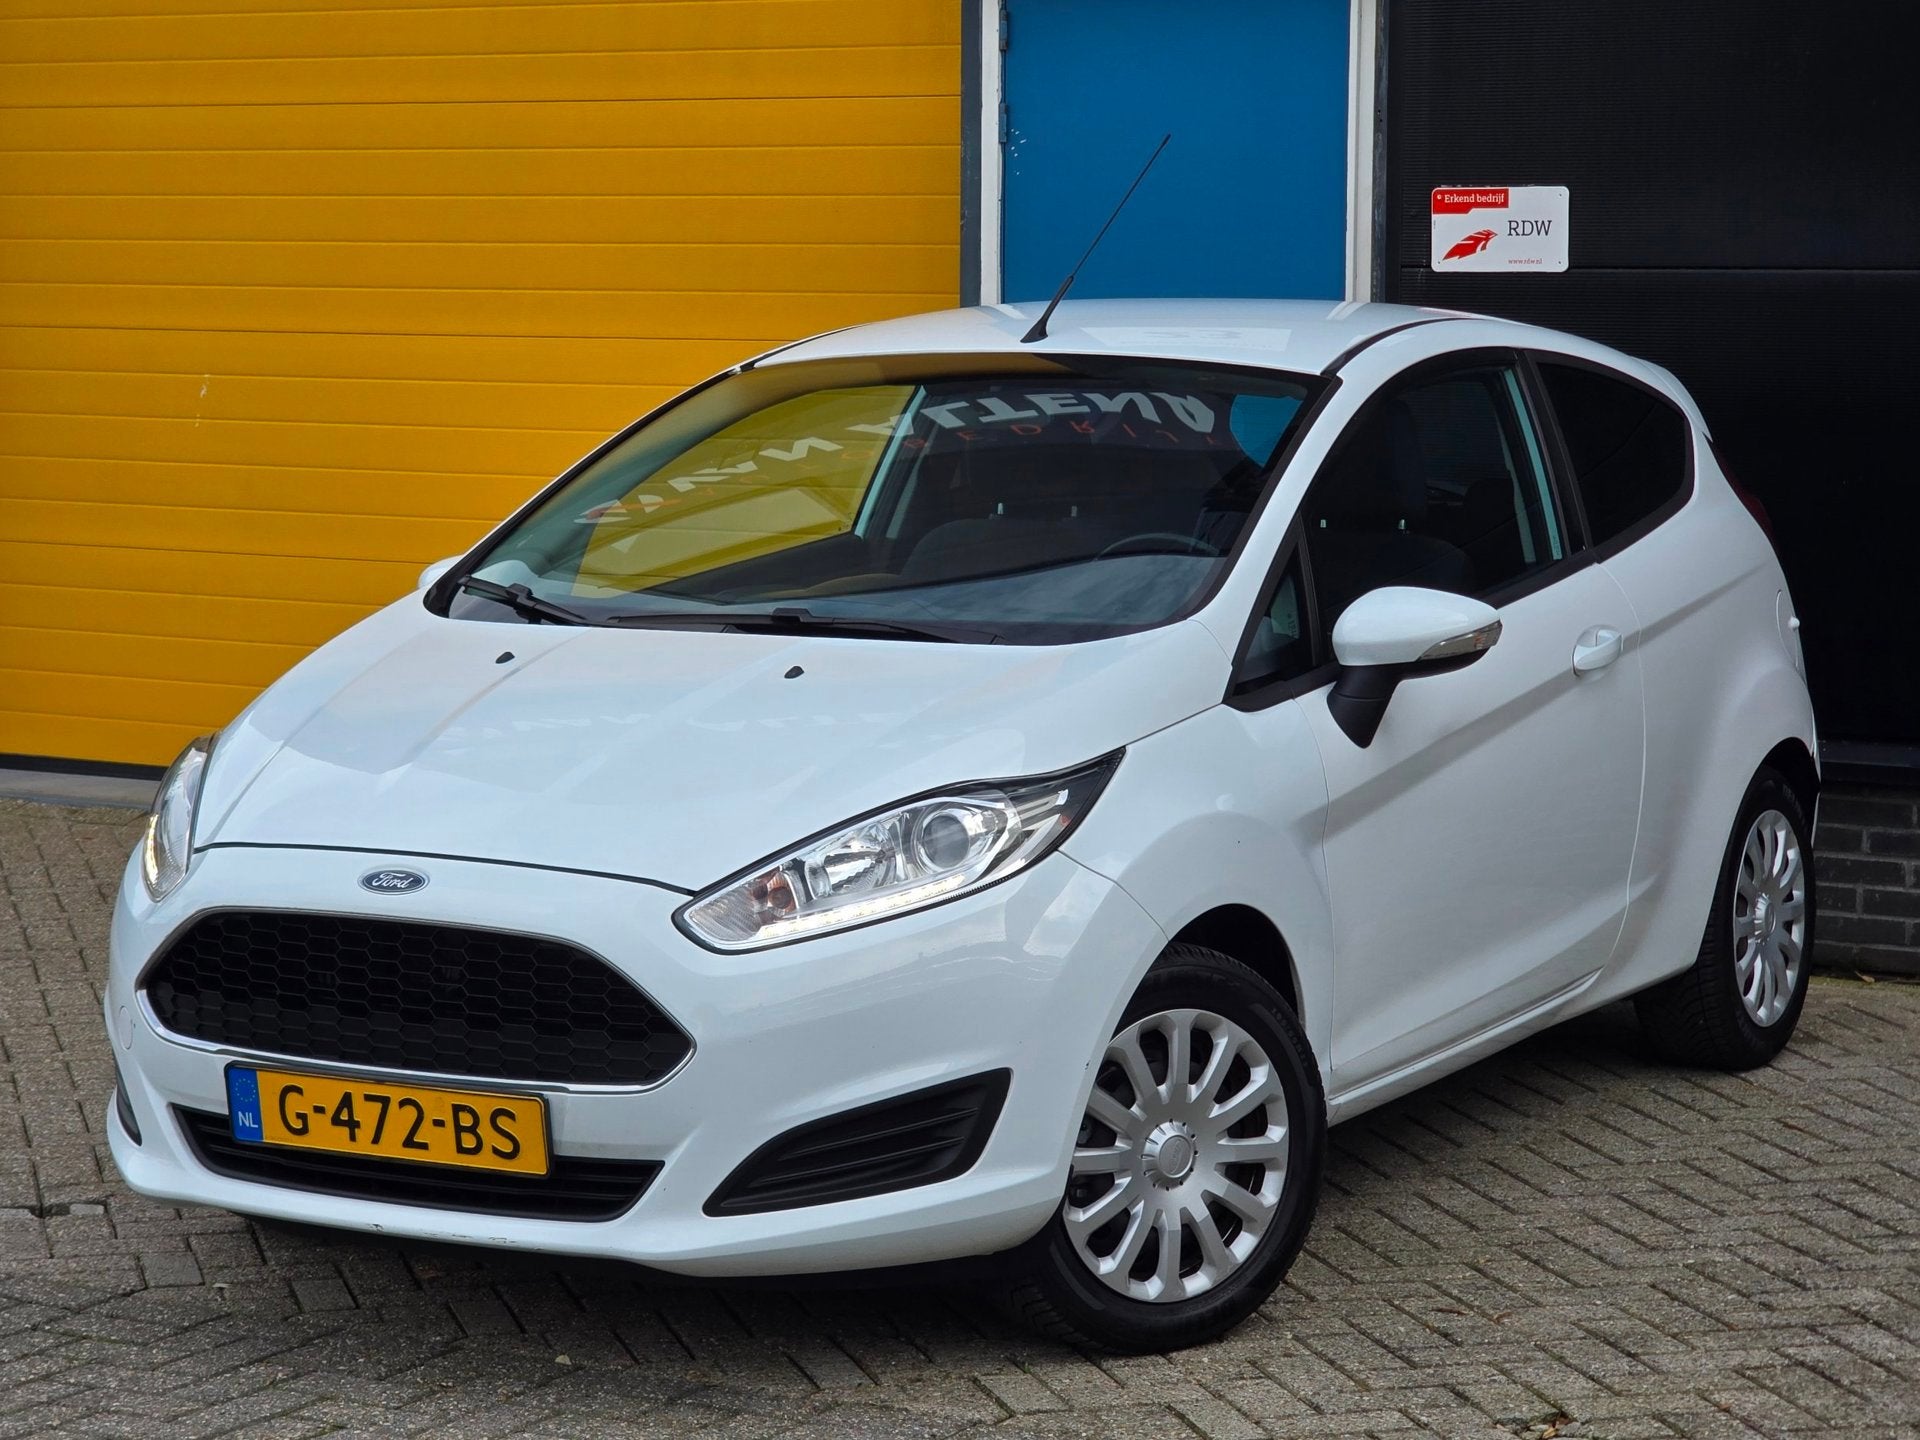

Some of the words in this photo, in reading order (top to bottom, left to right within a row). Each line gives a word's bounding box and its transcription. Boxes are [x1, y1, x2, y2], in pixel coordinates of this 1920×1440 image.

[1444, 194, 1474, 203] Erkend
[1477, 193, 1505, 205] bedrijf
[1507, 220, 1553, 236] RDW
[371, 872, 414, 889] Ford
[238, 1110, 259, 1129] NL
[278, 1083, 521, 1161] G-472-BS
